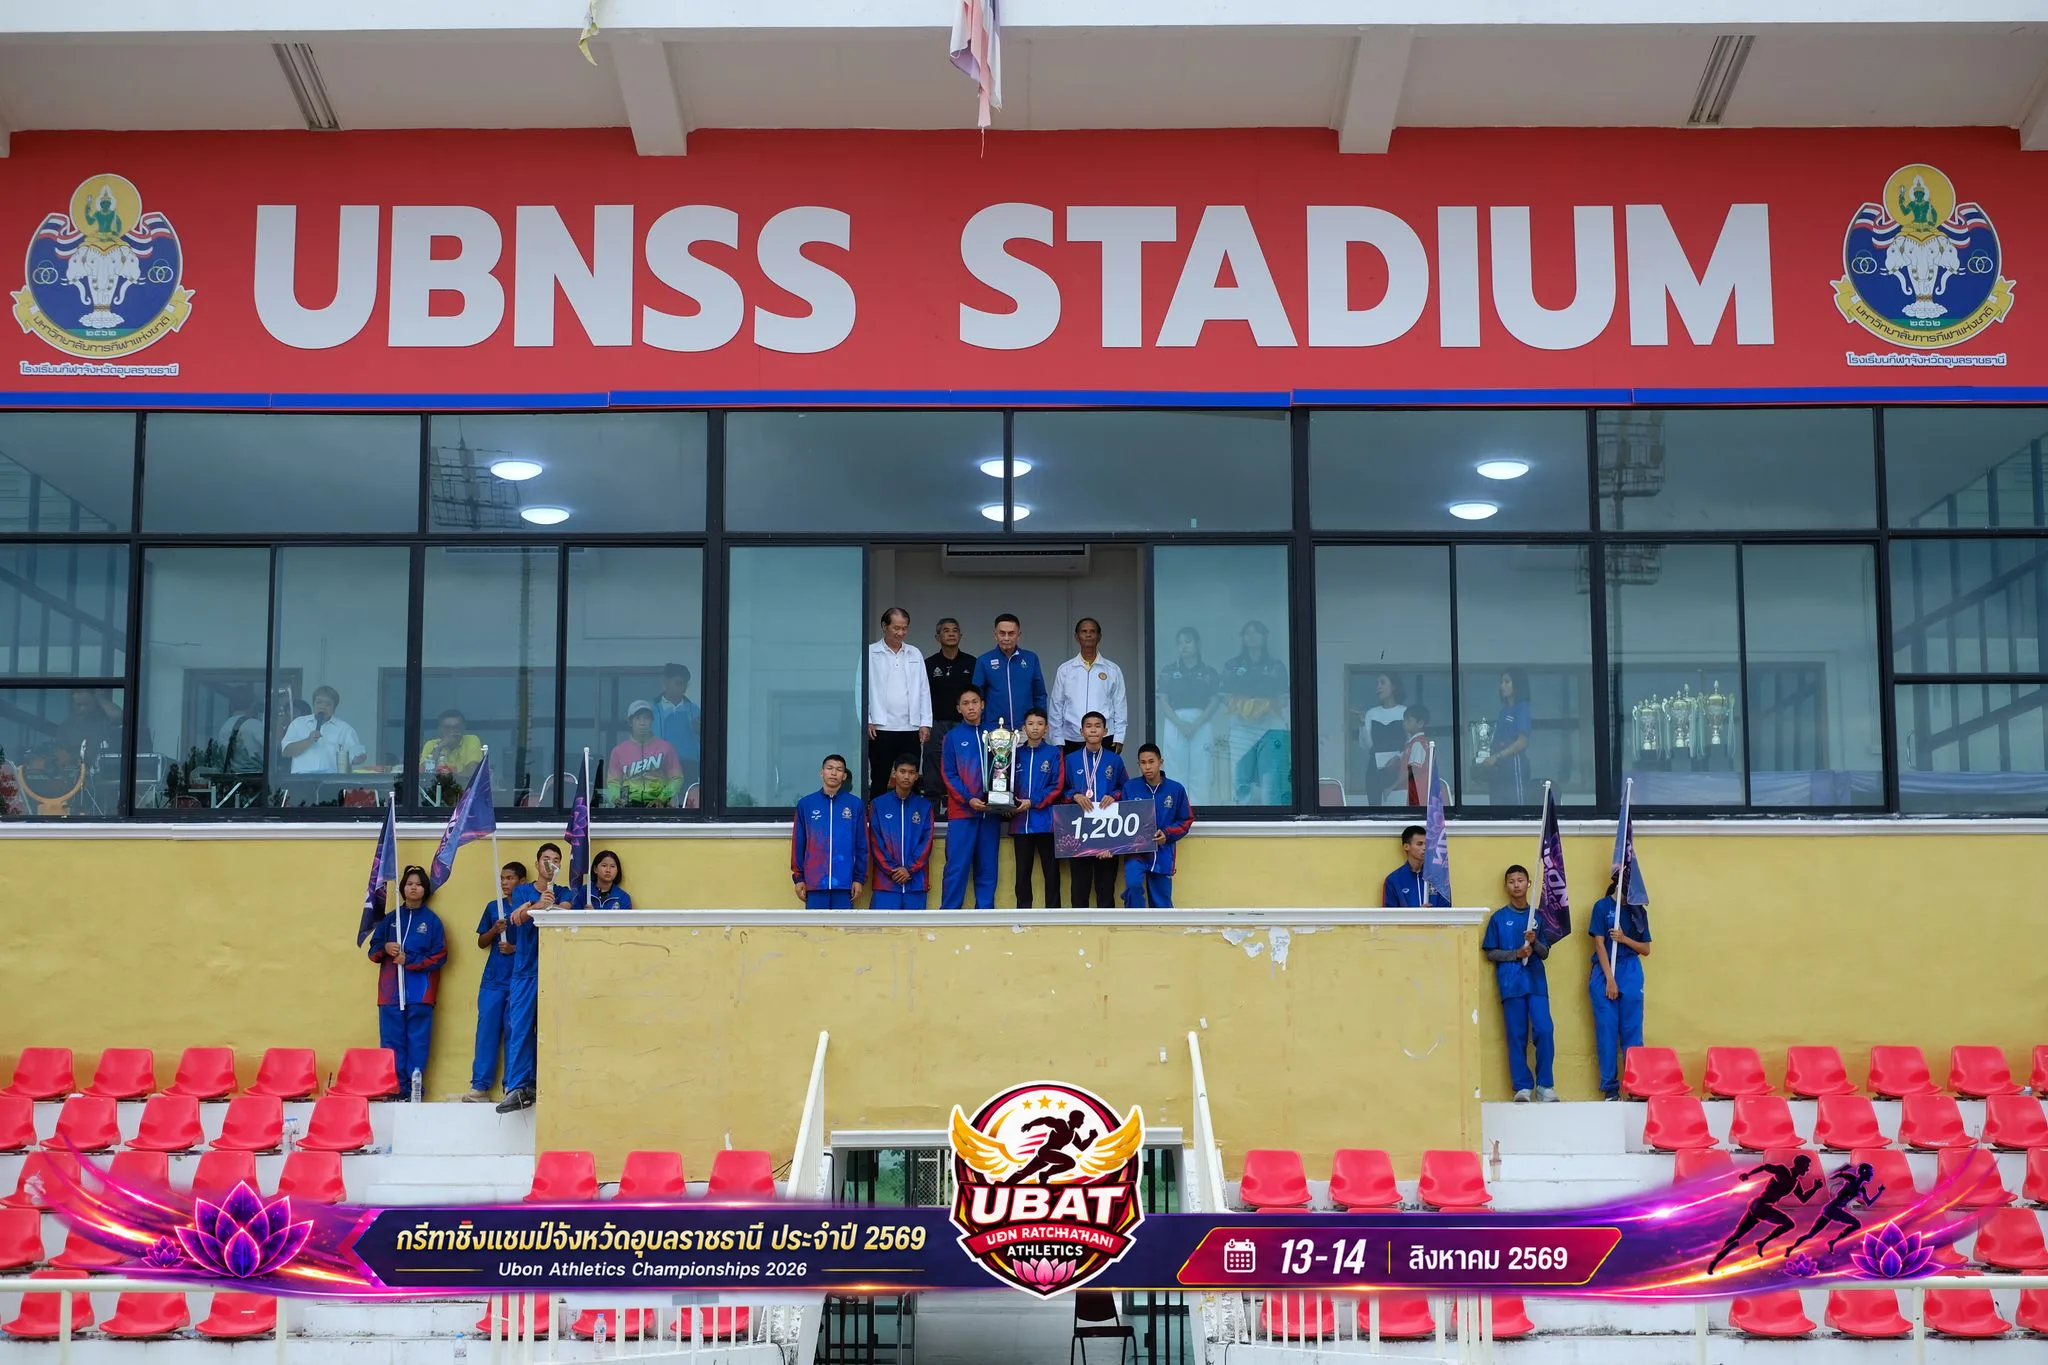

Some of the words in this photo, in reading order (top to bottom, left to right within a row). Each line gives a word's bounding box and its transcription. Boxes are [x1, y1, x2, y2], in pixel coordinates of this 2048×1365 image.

[253, 204, 857, 354] UBNSS
[959, 202, 1775, 350] STADIUM
[21, 362, 177, 377] โรงเรียนกีฬาจังหวัดอุบลราชธานี
[1848, 353, 2006, 368] โรงเรียนกีฬาจังหวัดอุบลราชธานี
[1071, 812, 1140, 843] 1,200
